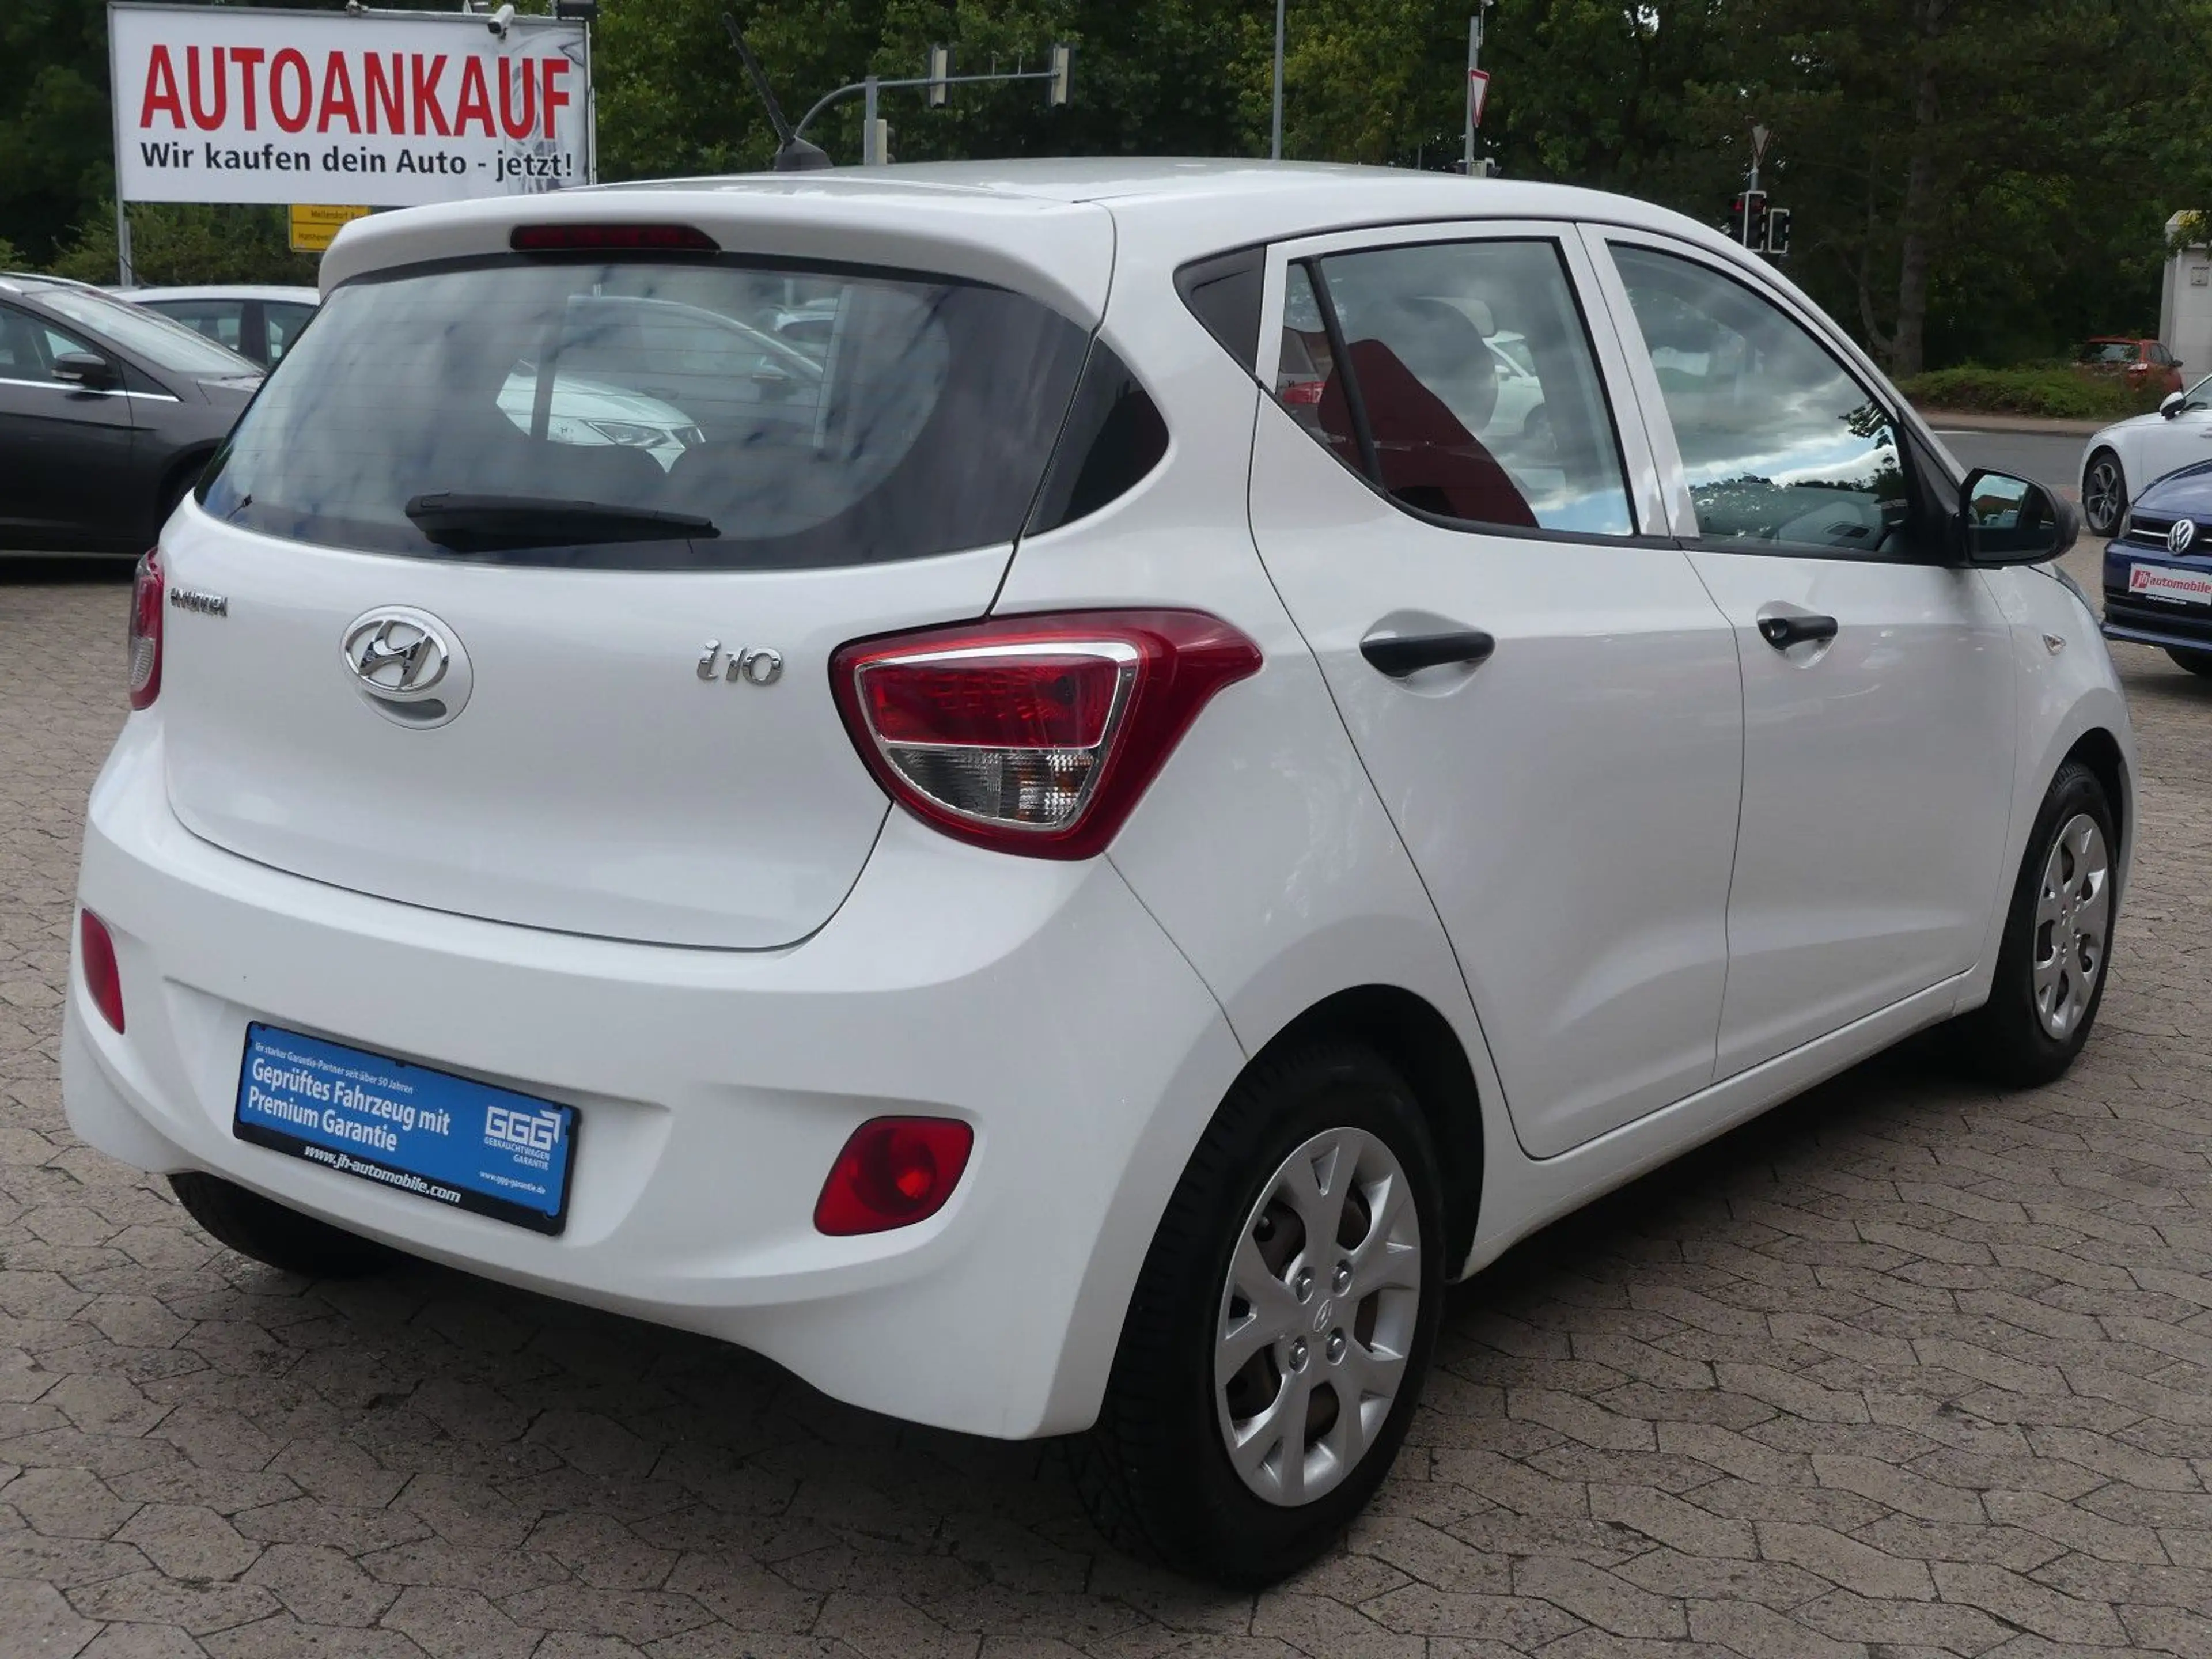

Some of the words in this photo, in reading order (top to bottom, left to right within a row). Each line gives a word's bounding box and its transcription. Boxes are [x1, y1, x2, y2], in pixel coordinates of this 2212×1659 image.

[139, 44, 570, 139] AUTOANKAUF
[141, 142, 194, 169] Wir
[206, 143, 310, 171] kaufen
[322, 146, 386, 173] dein
[396, 149, 467, 175] Auto
[495, 151, 573, 181] jetzt!
[696, 639, 782, 686] i10
[252, 1058, 330, 1101] Geprüftes
[333, 1081, 415, 1131] Fahrzeug
[418, 1108, 451, 1136] mit
[346, 1068, 358, 1080] seit
[359, 1069, 377, 1084] über
[378, 1078, 388, 1088] 50
[388, 1079, 413, 1094] Jahren
[248, 1085, 319, 1128] Premium
[322, 1109, 397, 1152] Garantie
[304, 1145, 461, 1203] www.jh-automobile.com
[513, 1154, 549, 1171] GARANTIE
